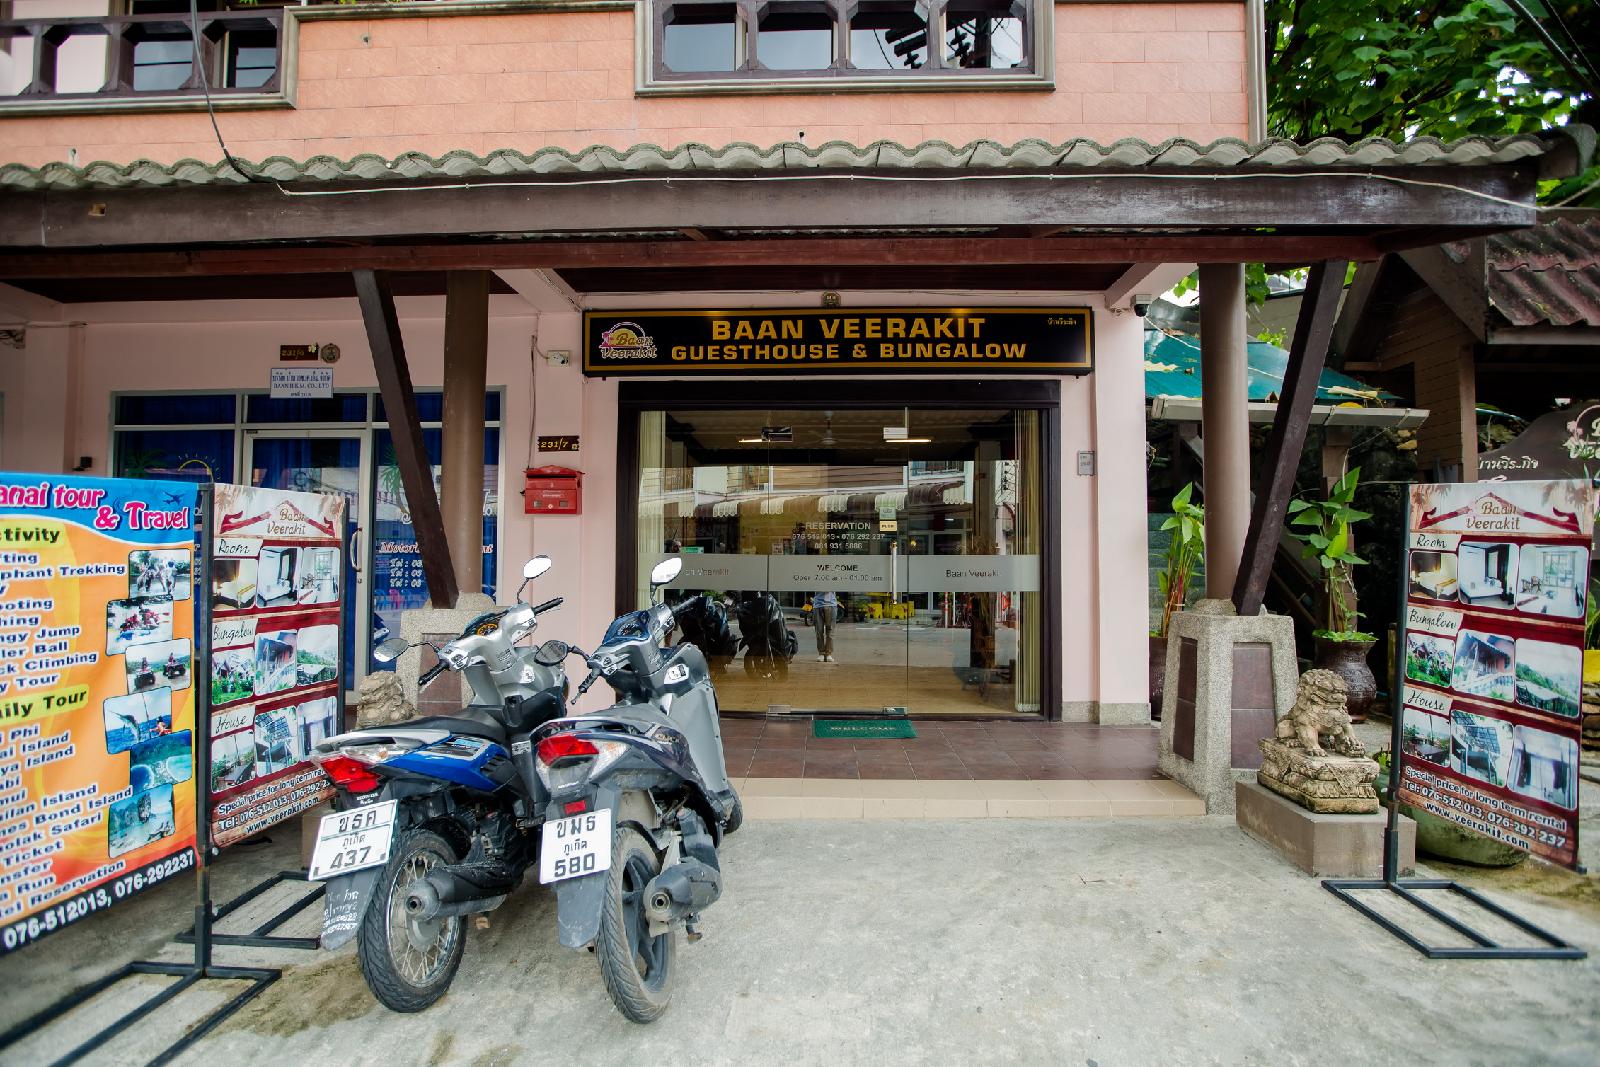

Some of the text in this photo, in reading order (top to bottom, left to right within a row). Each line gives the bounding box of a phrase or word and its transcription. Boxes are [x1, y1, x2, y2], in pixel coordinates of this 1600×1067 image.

[713, 317, 986, 340] BAAN VEERAKIT
[671, 343, 1027, 361] GUESTHOUSE & BUNGALOW
[540, 437, 568, 450] 231/7
[54, 485, 104, 508] tour
[95, 501, 189, 530] & Travel
[1481, 502, 1517, 515] Baan
[805, 522, 871, 530] RESERVATION
[1466, 516, 1520, 530] Veerakit
[0, 527, 60, 543] tivity
[1416, 534, 1447, 548] Room
[218, 539, 251, 554] Room
[0, 553, 38, 565] ting
[816, 564, 859, 572] WELCOME
[60, 564, 126, 576] Trekking
[1409, 608, 1457, 630] Bungalow
[36, 627, 80, 639] Jump
[213, 620, 254, 645] Bungalow
[34, 641, 68, 654] Ball
[24, 653, 98, 671] Climbing
[16, 674, 59, 688] Tour
[0, 690, 88, 718] ily Tour
[1408, 690, 1444, 710] House
[11, 725, 39, 740] Phi
[215, 714, 247, 734] House
[22, 732, 70, 753] Island
[27, 745, 74, 767] Island
[34, 803, 81, 825] Bond
[88, 787, 133, 809] Island
[42, 784, 97, 808] Island
[218, 796, 247, 815] Special
[1405, 766, 1567, 832] Special price for long term rental
[51, 812, 102, 835] Safari
[1405, 779, 1566, 848] Tel: 076-512 013, 076-292 237
[1426, 802, 1529, 849] www.veerakit.com
[3, 840, 63, 867] Ticket
[329, 845, 372, 869] 437
[554, 852, 596, 877] 580
[17, 875, 54, 894] Run
[30, 861, 124, 906] Reservation
[4, 849, 194, 949] 076-512013, 076-292237
